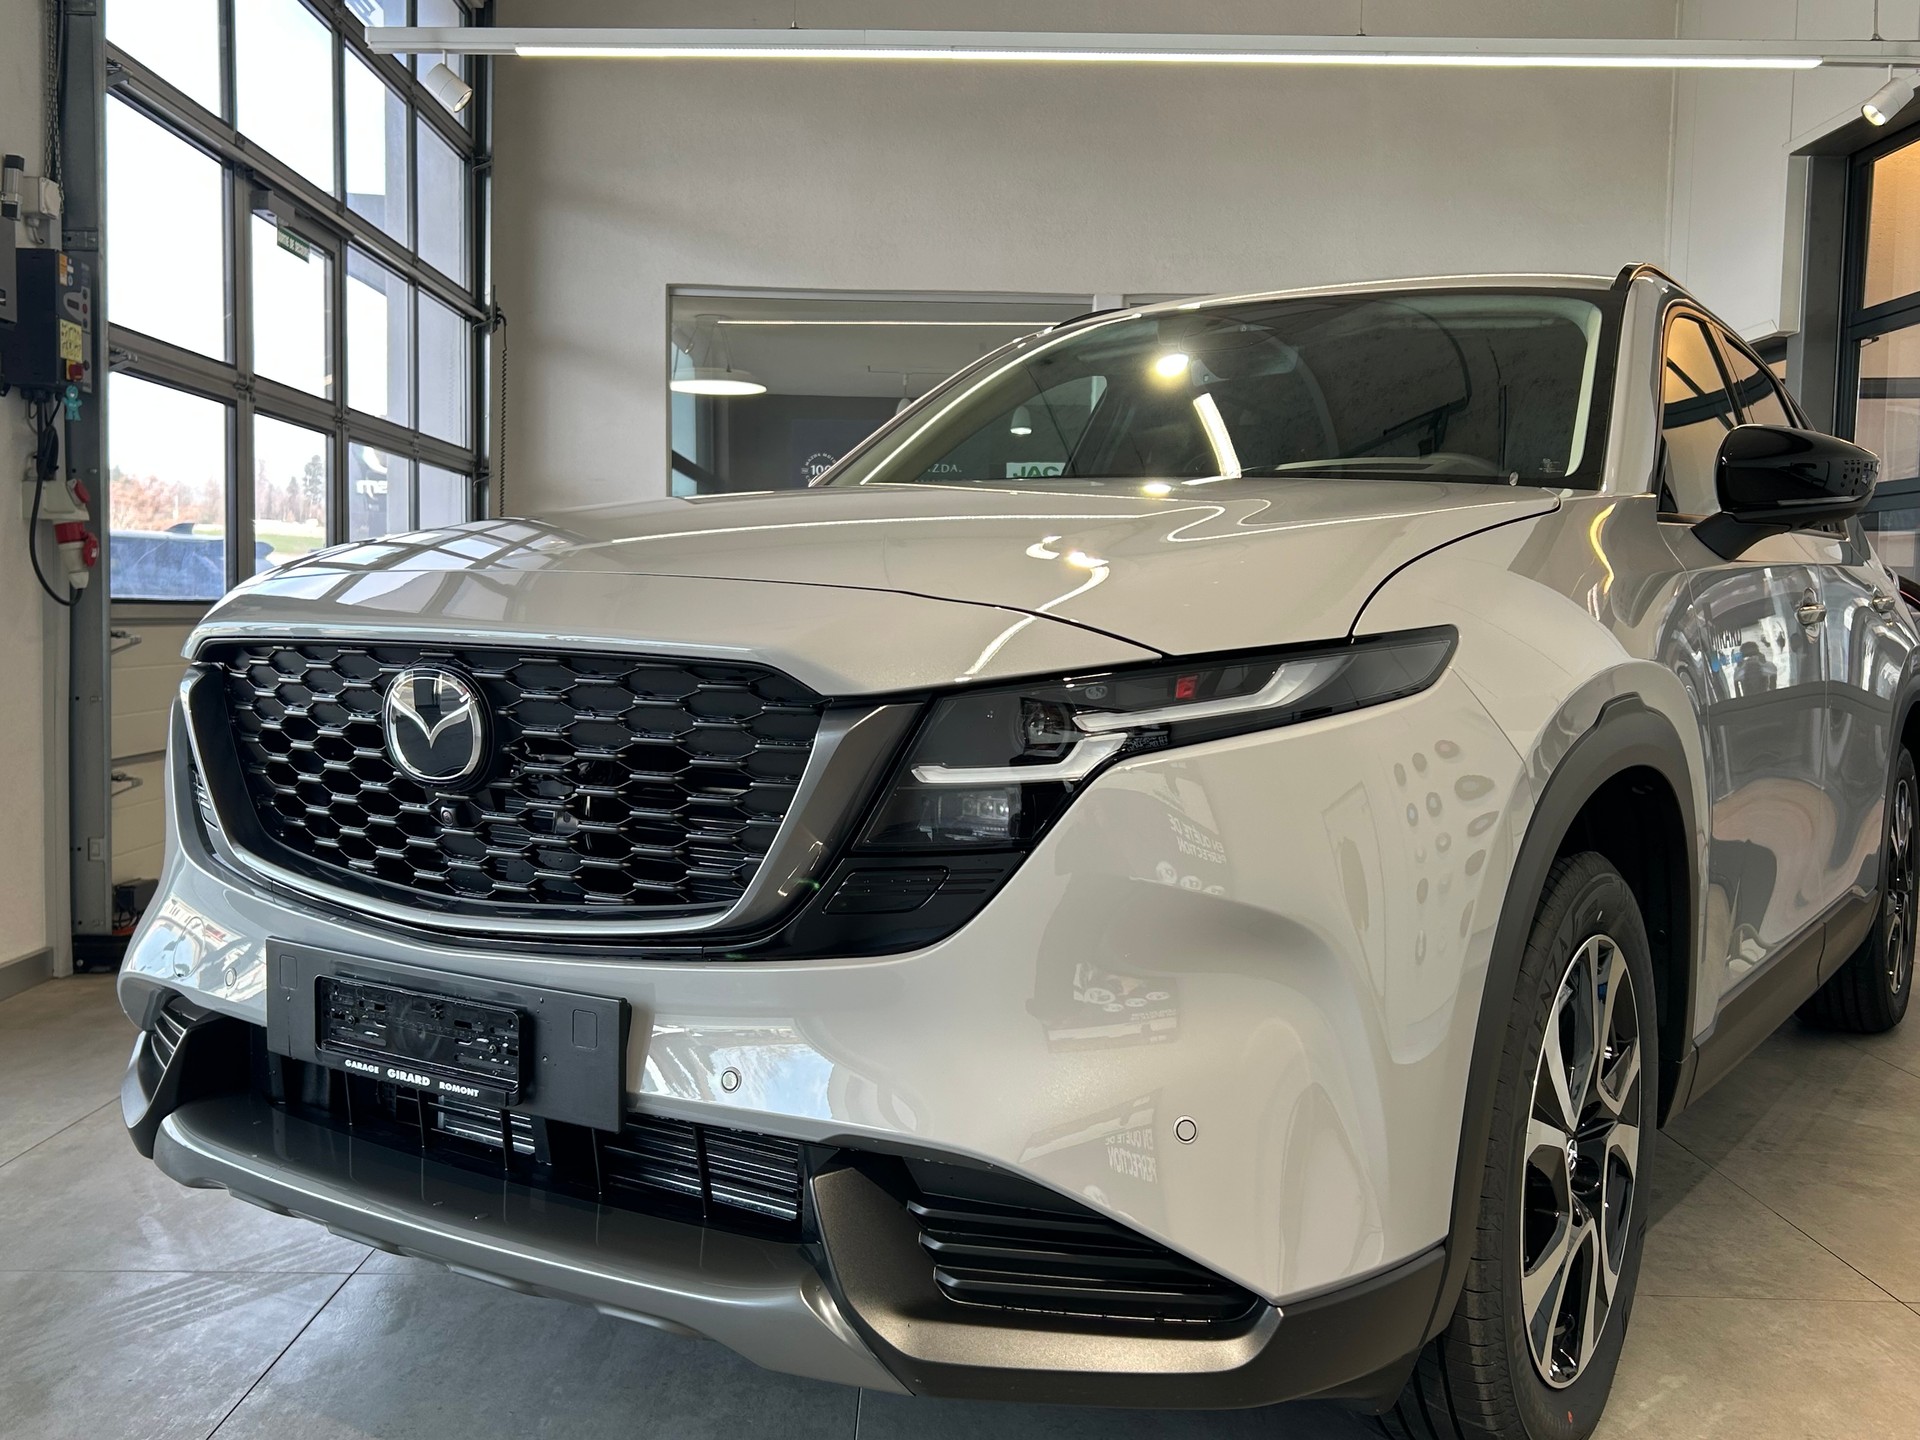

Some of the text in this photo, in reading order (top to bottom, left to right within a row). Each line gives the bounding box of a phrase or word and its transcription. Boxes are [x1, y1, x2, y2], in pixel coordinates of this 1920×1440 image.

[345, 1059, 480, 1098] GARAGE GIRARD ROMONT
